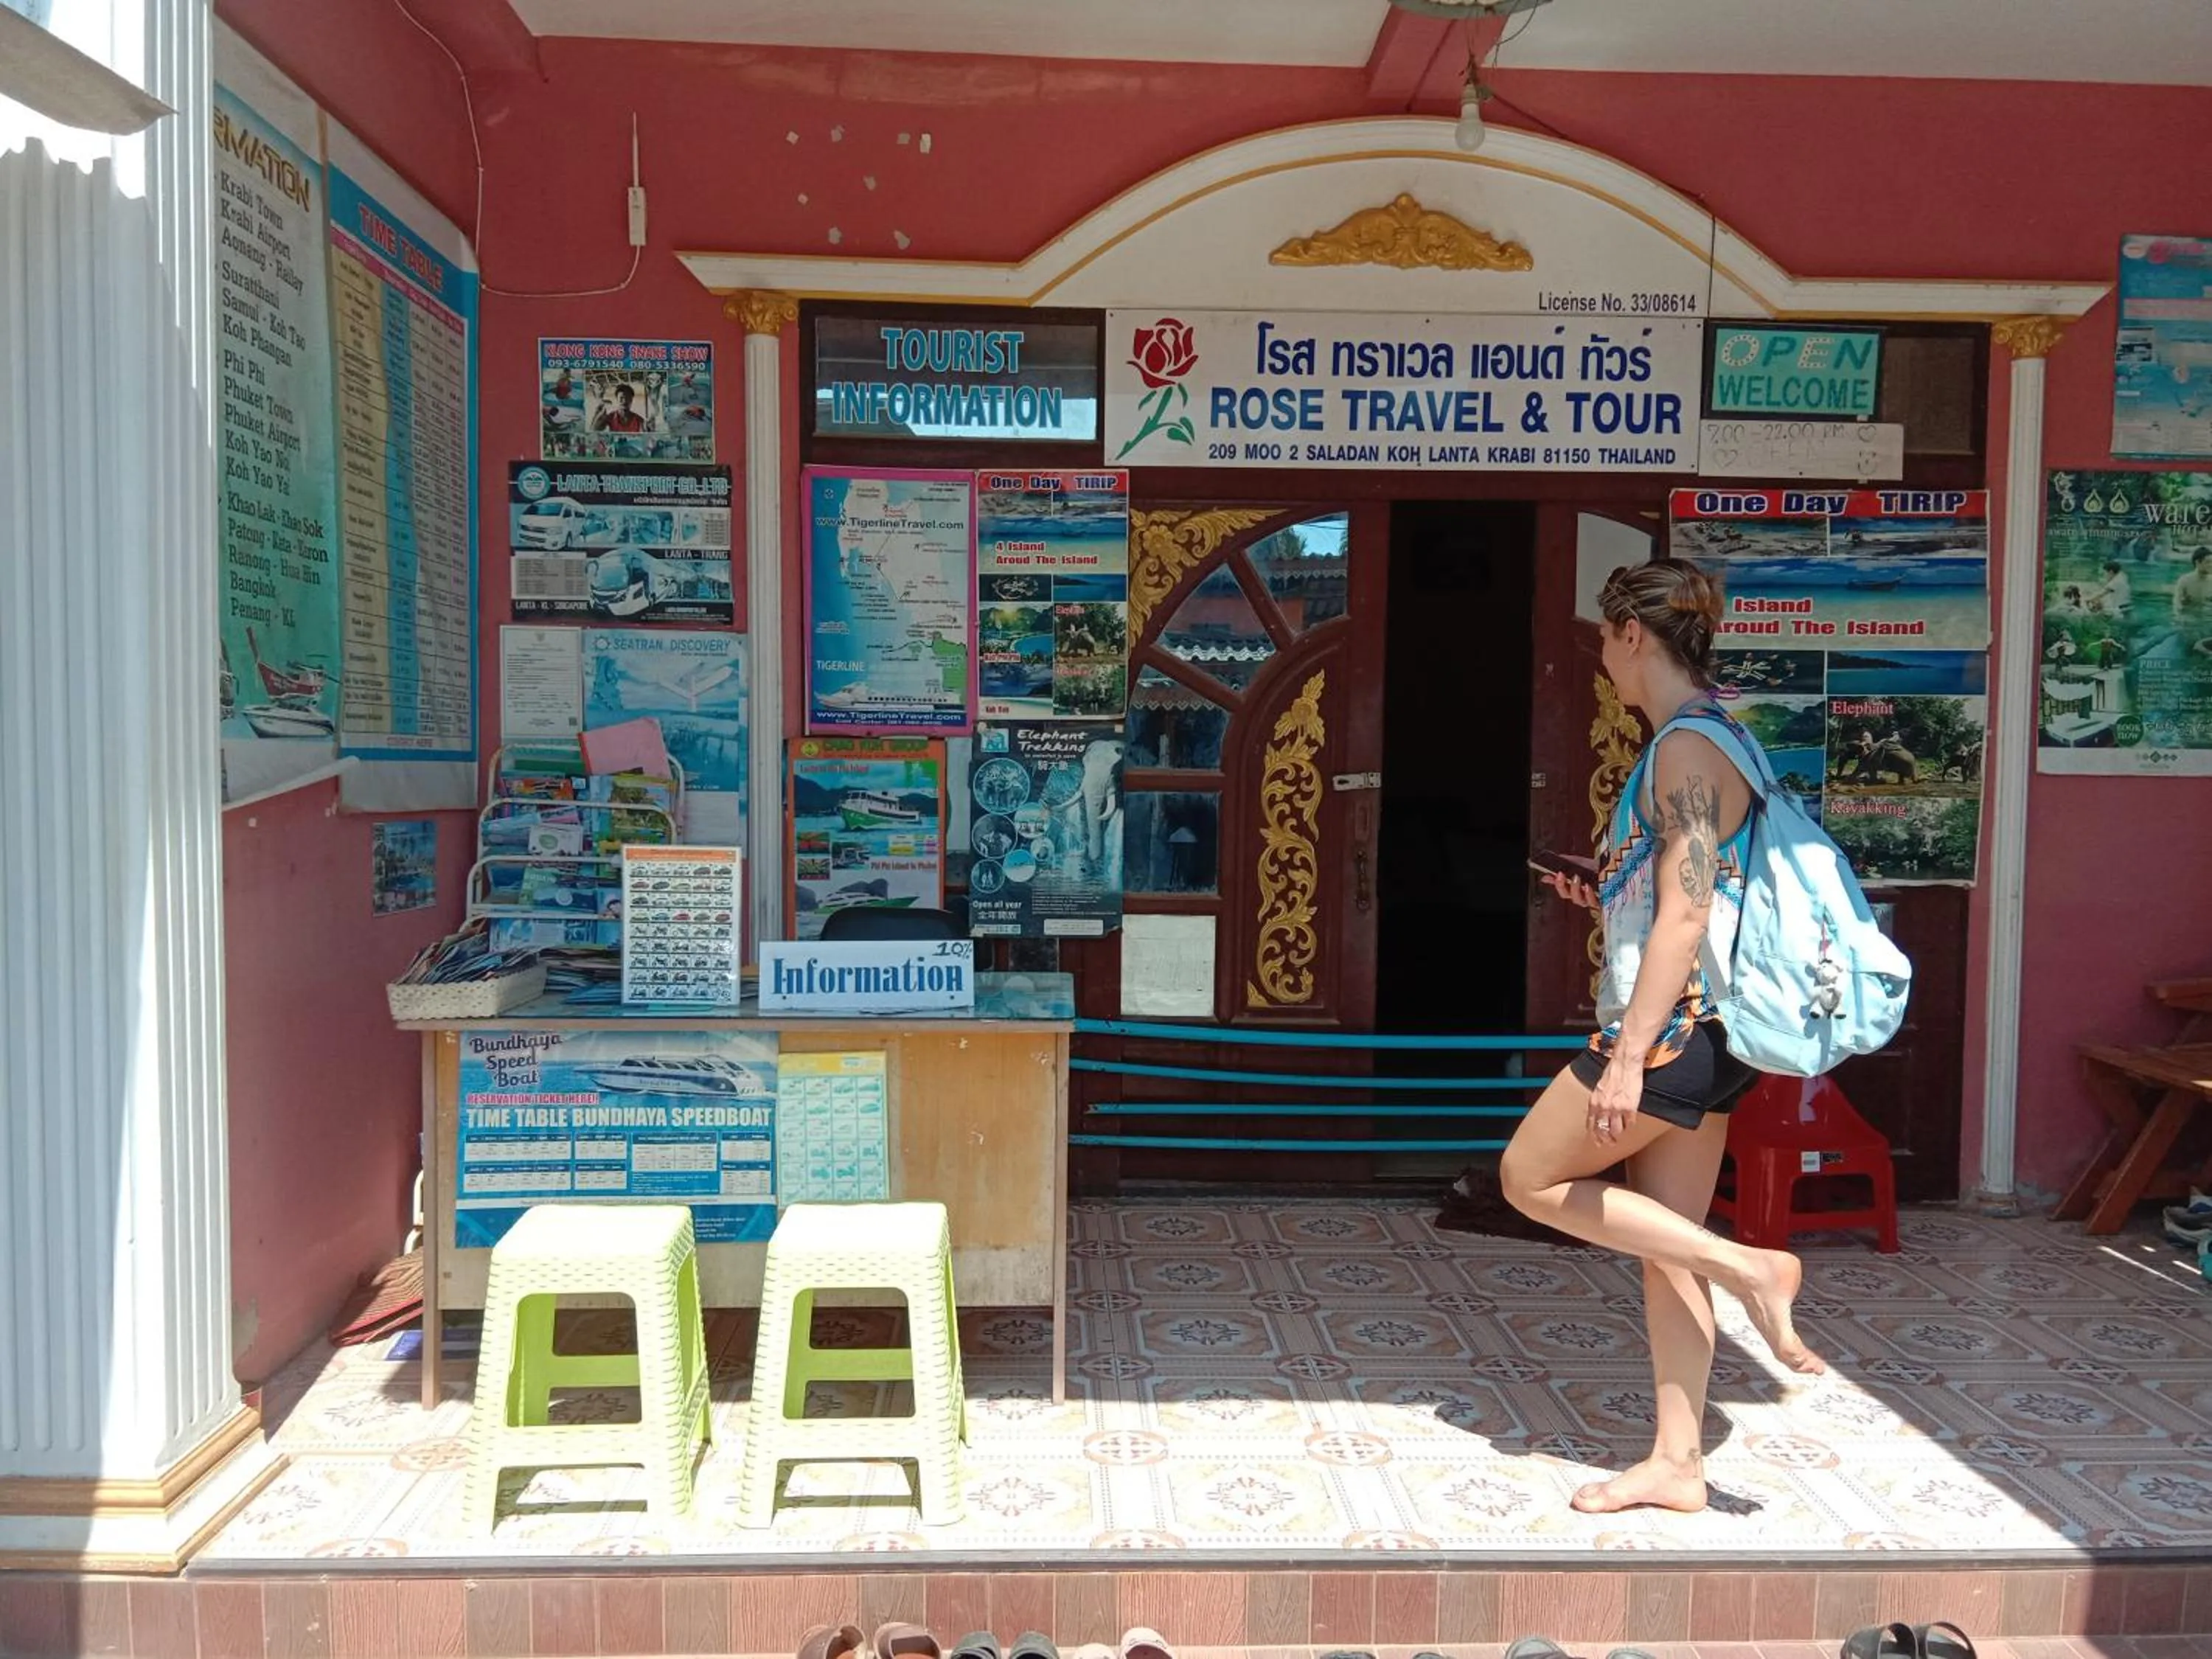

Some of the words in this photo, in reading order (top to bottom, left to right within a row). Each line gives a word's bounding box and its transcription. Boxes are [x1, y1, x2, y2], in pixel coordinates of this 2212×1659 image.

[221, 170, 253, 209] Krabi
[256, 193, 284, 231] Town
[221, 198, 253, 234] Krabi
[358, 202, 397, 258] TIME
[399, 235, 444, 293] TABLE
[1538, 292, 1596, 312] License
[1601, 293, 1626, 313] No.
[1630, 293, 1697, 313] 33/08614
[223, 313, 247, 343] Koh
[881, 327, 1024, 374] TOURIST
[1257, 321, 1316, 375] โรส
[1332, 341, 1454, 378] ทราเวล
[1471, 325, 1565, 380] แอนด์
[1580, 327, 1652, 381] ทัวร์
[1720, 333, 1874, 370] OPEN
[223, 349, 245, 376] Phi
[248, 359, 265, 386] Phi
[223, 375, 264, 411] Phuket
[266, 394, 293, 425] Town
[830, 380, 1062, 428] INFORMATION
[1717, 373, 1871, 410] WELCOME
[224, 403, 264, 437] Phuket
[1209, 387, 1324, 431] ROSE
[1341, 389, 1504, 433] TRAVEL
[1520, 392, 1549, 434] &
[1565, 392, 1682, 434] TOUR
[225, 429, 248, 456] Koh
[1208, 444, 1237, 461] 209
[1245, 444, 1282, 461] MOO
[1290, 445, 1299, 461] 2
[1306, 445, 1380, 462] SALADAN
[1387, 446, 1421, 463] KOH
[1428, 446, 1480, 464] LANTA
[1487, 447, 1536, 464] KRABI
[1543, 448, 1590, 465] 81150
[1599, 448, 1677, 465] THAILAND
[226, 456, 249, 481] Koh
[991, 477, 1023, 490] One
[1029, 477, 1061, 491] Day
[1696, 492, 1768, 515] One
[1781, 492, 1848, 517] Day
[1878, 491, 1967, 515] TIRIP
[228, 518, 265, 549] Patong
[303, 518, 326, 540] Sok
[229, 544, 271, 577] Ranong
[230, 571, 277, 599] Bangkok
[231, 597, 271, 627] Penang
[1733, 597, 1813, 615] Island
[1791, 620, 1836, 636] The
[1846, 620, 1925, 637] Island
[613, 639, 664, 650] SEATRAN
[669, 639, 731, 653] DISCOVERY
[815, 659, 866, 672] TIGERLINE
[1832, 701, 1894, 716] Elephant
[1016, 728, 1090, 742] Elephant
[1016, 740, 1087, 753] Trekking
[771, 956, 964, 995] Information
[468, 1034, 565, 1054] Bundhaya
[485, 1046, 539, 1074] Speed
[493, 1069, 540, 1088] Boat
[466, 1107, 510, 1128] TIME
[515, 1107, 568, 1128] TABLE
[572, 1107, 667, 1128] BUNDHAYA
[671, 1106, 772, 1127] SPEEDBOAT
